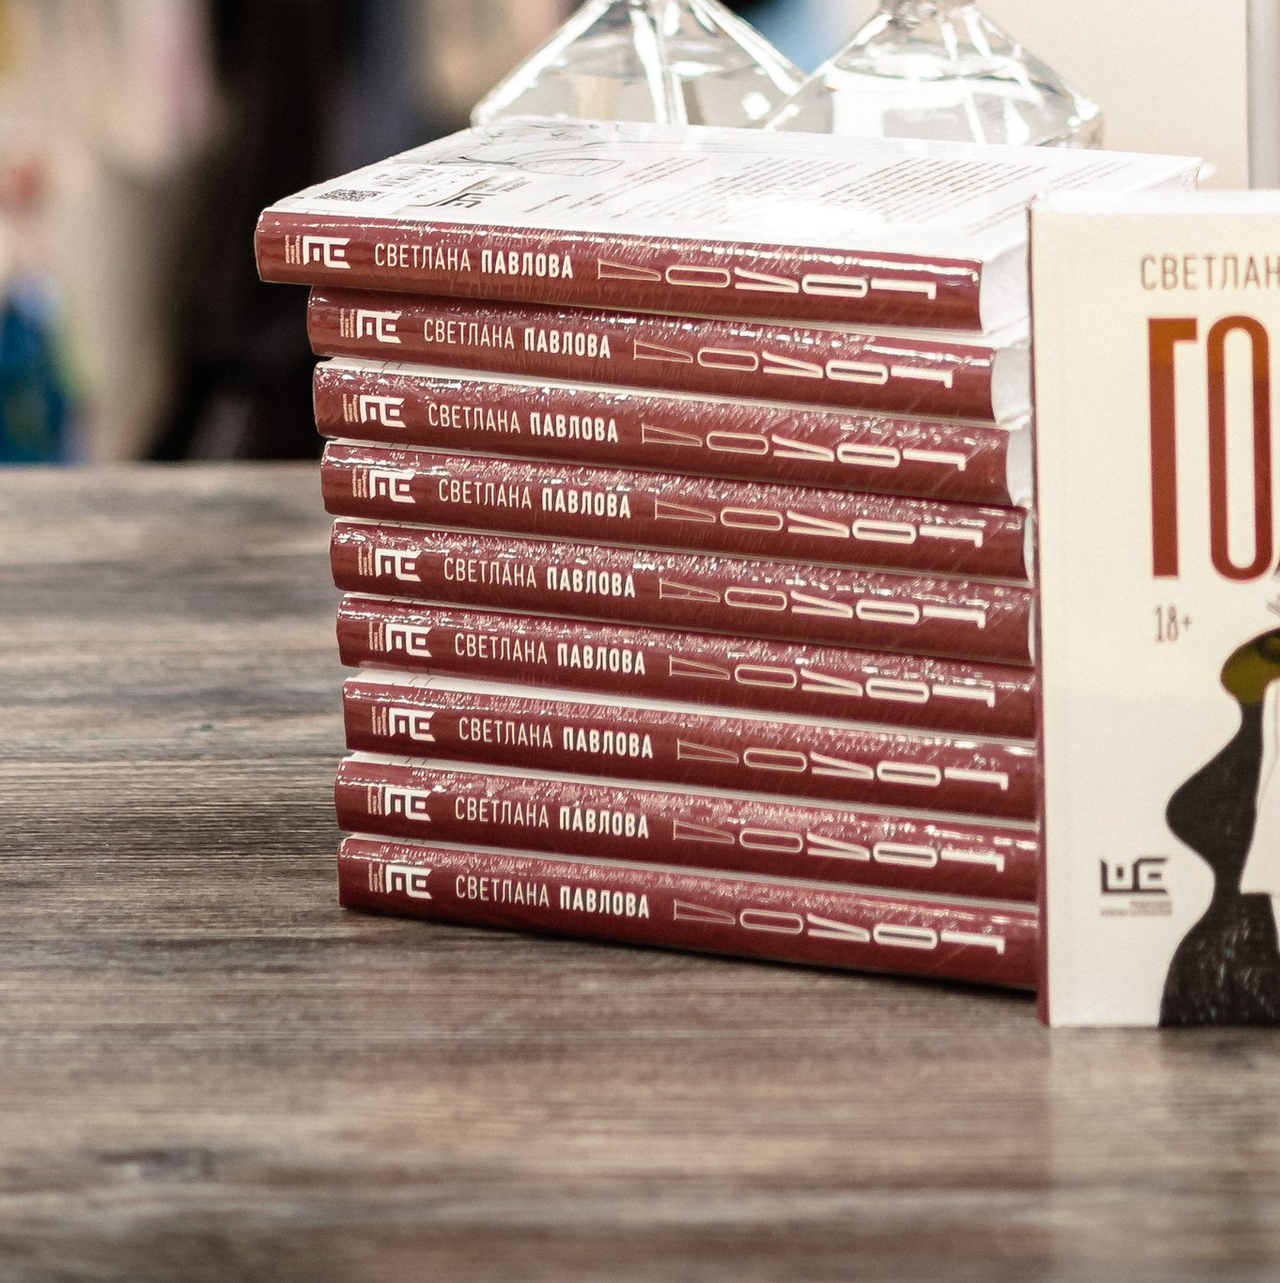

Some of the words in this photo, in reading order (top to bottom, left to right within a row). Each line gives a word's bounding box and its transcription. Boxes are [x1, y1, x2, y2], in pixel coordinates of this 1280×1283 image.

[375, 243, 472, 273] СВЕТЛАНА
[481, 254, 573, 279] ПАВЛОВА
[424, 319, 515, 349] СВЕТЛАНА
[524, 328, 612, 360] ПАВЛОВА
[428, 403, 521, 435] СВЕТЛАНА
[530, 415, 619, 444] ПАВЛОВА
[439, 479, 532, 510] СВЕТЛАНА
[542, 489, 631, 519] ПАВЛОВА
[444, 557, 538, 590] СВЕТЛАНА
[546, 567, 636, 598] ПАВЛОВА
[1154, 605, 1192, 643] 18+
[454, 633, 547, 665] СВЕТЛАНА
[557, 645, 646, 676] ПАВЛОВА
[459, 717, 554, 749] СВЕТЛАНА
[563, 728, 653, 759] ПАВЛОВА
[454, 796, 548, 829] СВЕТЛАНА
[560, 807, 649, 840] ПАВЛОВА
[455, 875, 549, 908] СВЕТЛАНА
[560, 886, 650, 920] ПАВЛОВА
